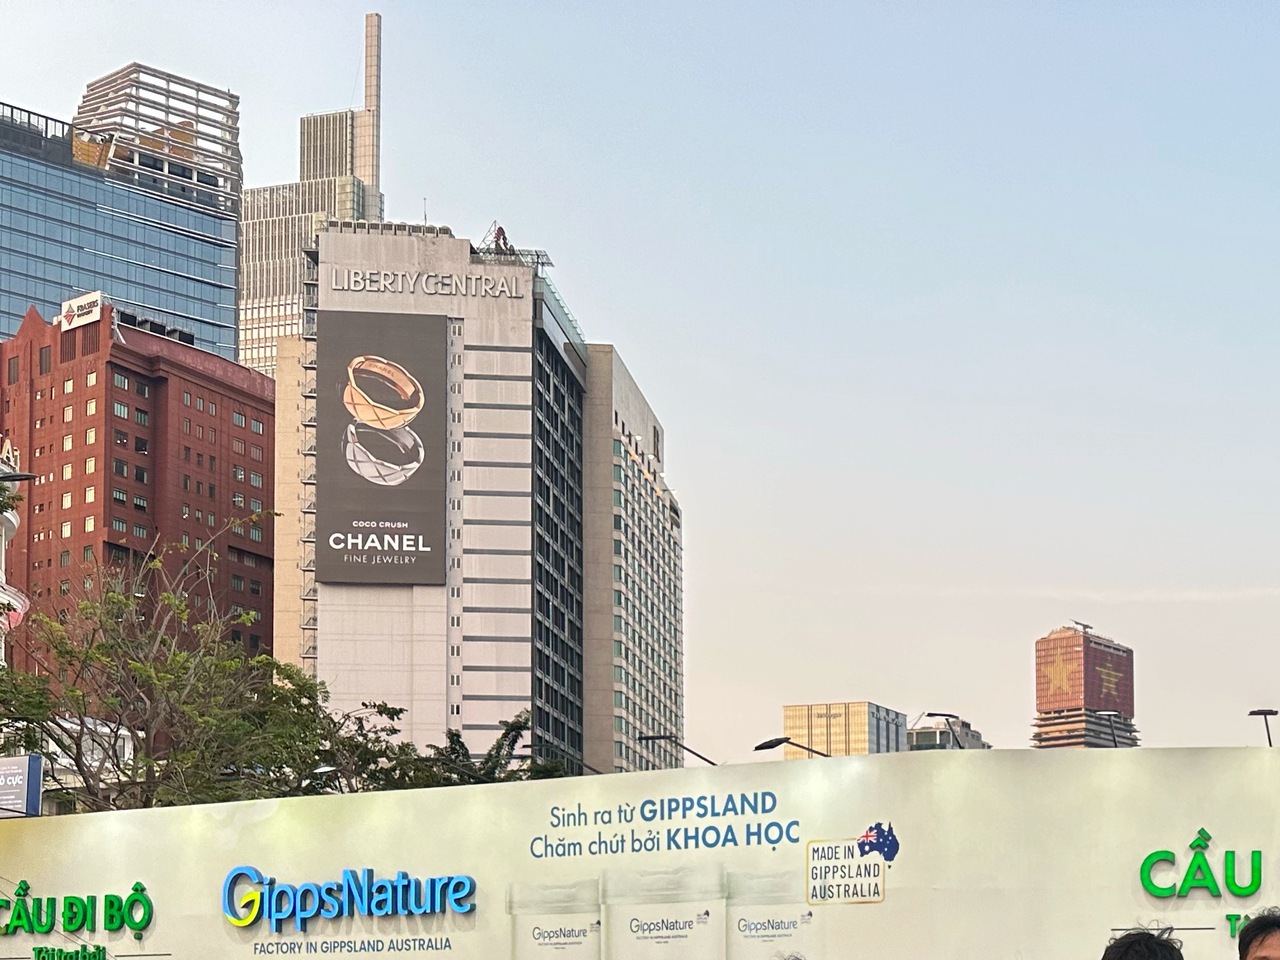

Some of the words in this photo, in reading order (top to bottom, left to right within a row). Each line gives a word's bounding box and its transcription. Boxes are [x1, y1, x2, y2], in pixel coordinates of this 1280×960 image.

[331, 268, 420, 294] LIBERTY
[421, 271, 524, 299] CENTRAL
[378, 521, 409, 529] CRUSH
[328, 532, 432, 552] CHANEL
[344, 554, 368, 563] FINE
[371, 555, 417, 565] JEWELRY
[550, 803, 588, 828] Sinh
[593, 808, 612, 826] ra
[617, 801, 636, 824] từ
[639, 791, 778, 822] GIPPSLAND
[529, 835, 583, 859] Chăm
[588, 831, 627, 856] chút
[631, 828, 661, 852] bởi
[666, 824, 739, 852] KHOA
[746, 820, 800, 853] HỌC
[812, 845, 841, 862] MADE
[843, 844, 855, 860] IN
[811, 863, 881, 880] GIPPSLAND
[1139, 827, 1263, 899] CẦU
[222, 866, 478, 933] GippsNature
[810, 882, 881, 900] AUSTRALIA
[62, 895, 97, 932] ĐI
[104, 881, 154, 941] BỘ
[532, 926, 588, 941] GippsNature
[629, 917, 694, 934] GippsNature
[737, 917, 798, 934] GippsNature
[1226, 913, 1252, 938] Tà
[253, 941, 304, 955] FACTORY
[306, 941, 318, 954] IN
[320, 939, 385, 954] GIPPSLAND
[387, 937, 452, 952] AUSTRALIA
